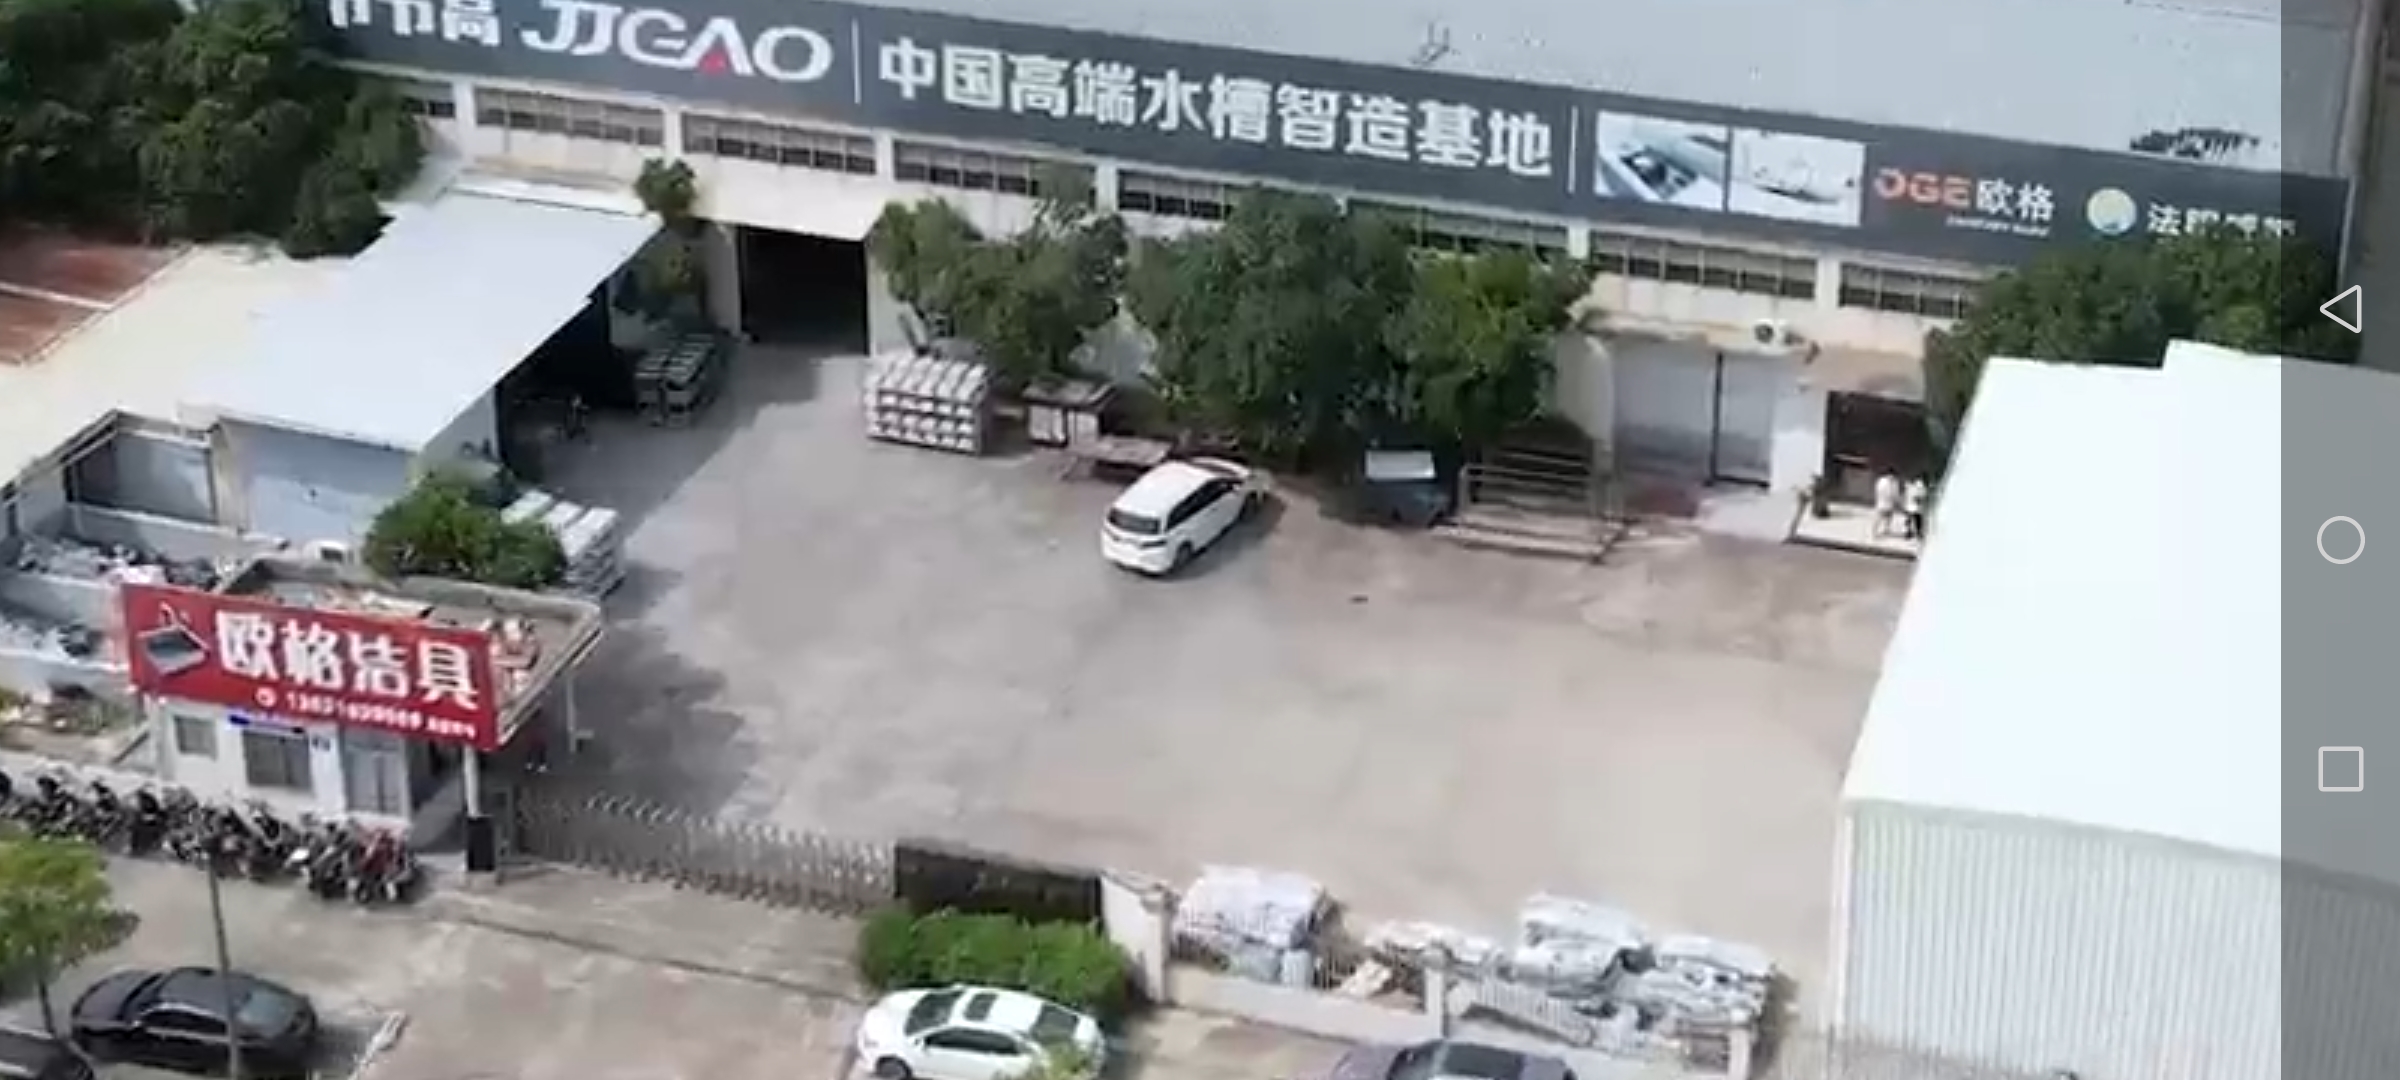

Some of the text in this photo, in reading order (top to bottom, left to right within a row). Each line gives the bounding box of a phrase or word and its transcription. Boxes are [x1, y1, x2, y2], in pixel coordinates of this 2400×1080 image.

[877, 36, 1553, 178] 中国高端水槽智造基地
[215, 610, 479, 710] 欧格洁具
